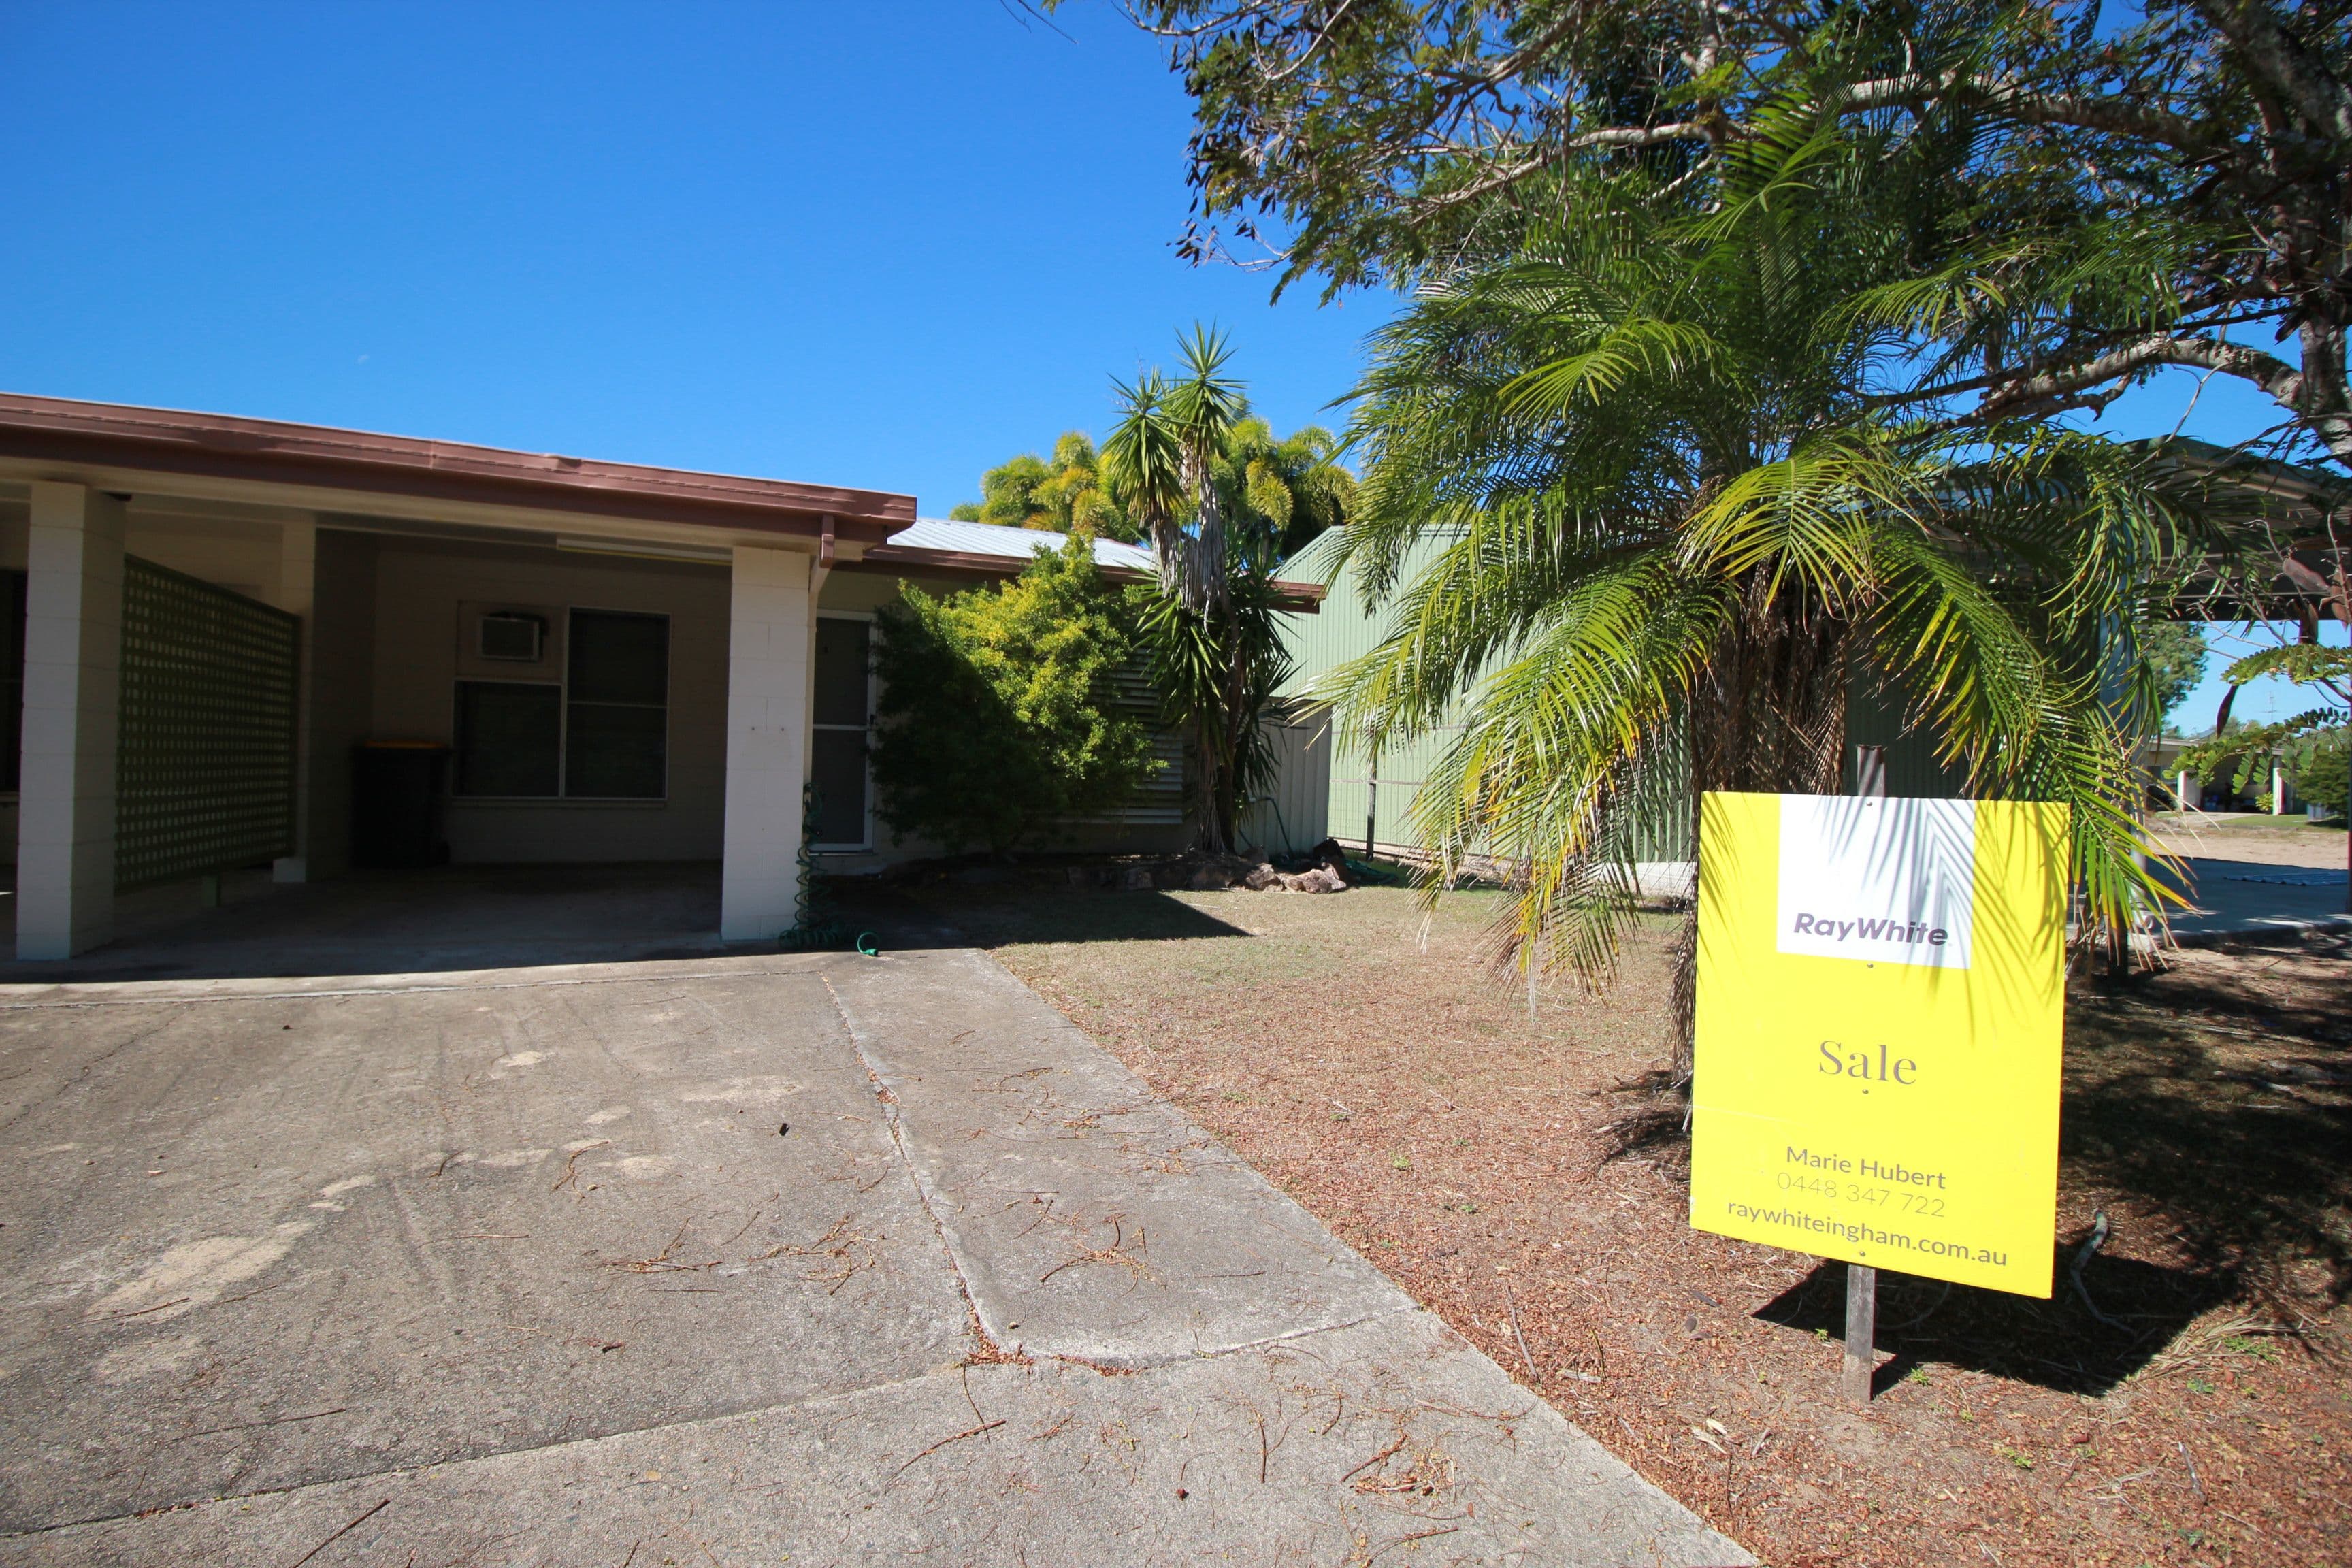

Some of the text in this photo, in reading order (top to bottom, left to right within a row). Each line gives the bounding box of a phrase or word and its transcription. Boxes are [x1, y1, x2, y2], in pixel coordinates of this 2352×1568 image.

[1819, 1040, 1917, 1085] Sale
[1786, 1146, 1946, 1190] Marie Hubert
[1777, 1172, 1945, 1218] 0448 347 722
[1728, 1201, 2007, 1266] raywhiteingham.com.au
